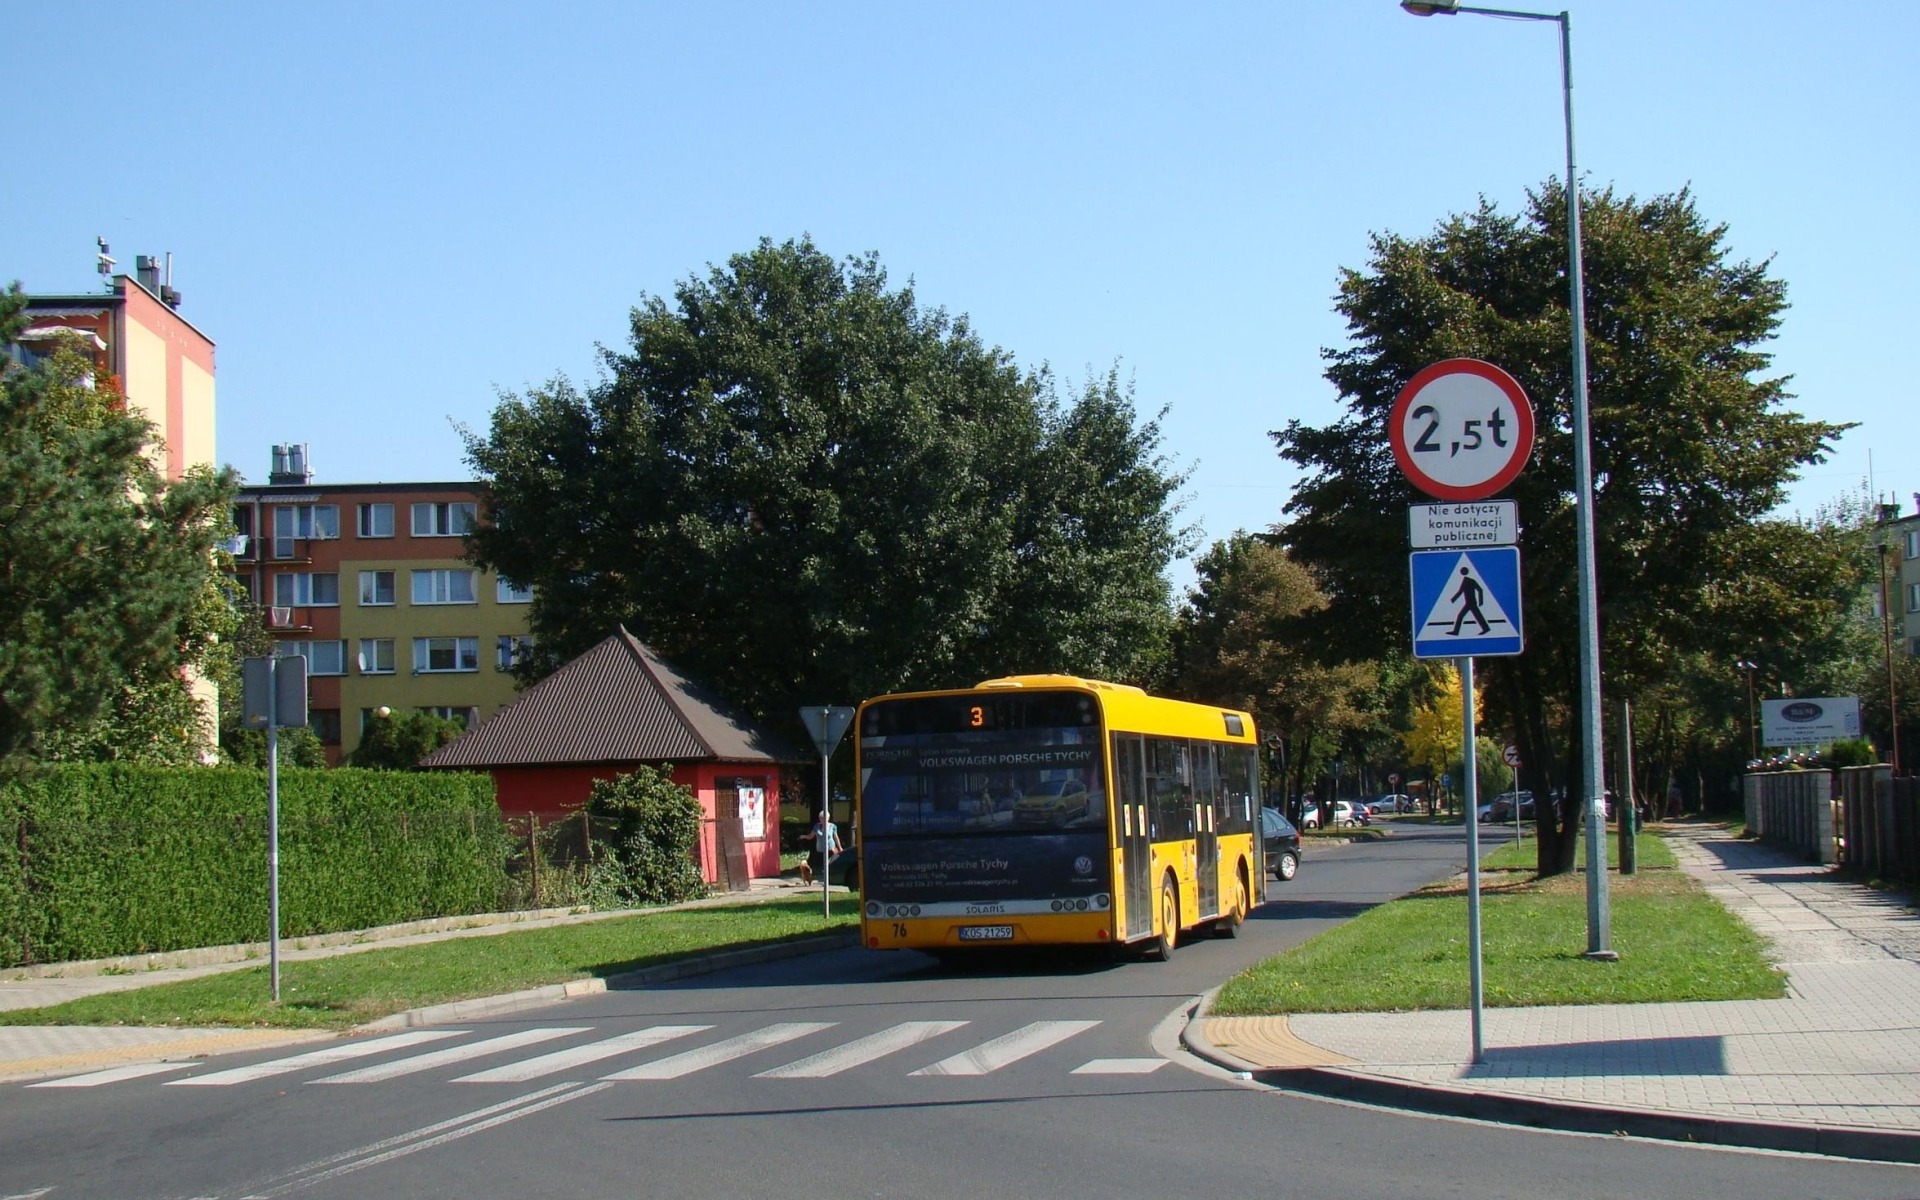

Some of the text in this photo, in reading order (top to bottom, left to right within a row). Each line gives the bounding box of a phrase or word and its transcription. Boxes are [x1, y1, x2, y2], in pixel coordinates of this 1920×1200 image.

[1412, 405, 1508, 457] 2,5t
[1429, 504, 1500, 519] Nie dotyczy
[1429, 517, 1502, 530] komunikacji
[1435, 530, 1497, 544] publicznej
[971, 706, 983, 726] 3
[919, 750, 1091, 769] VOLKSWAGEN PORSCHE TYCHY
[940, 860, 978, 871] Porsche
[980, 858, 1009, 871] Tychy
[966, 904, 1005, 914] SOLARIS
[892, 924, 907, 938] 76
[965, 927, 1011, 939] KOS 21259
